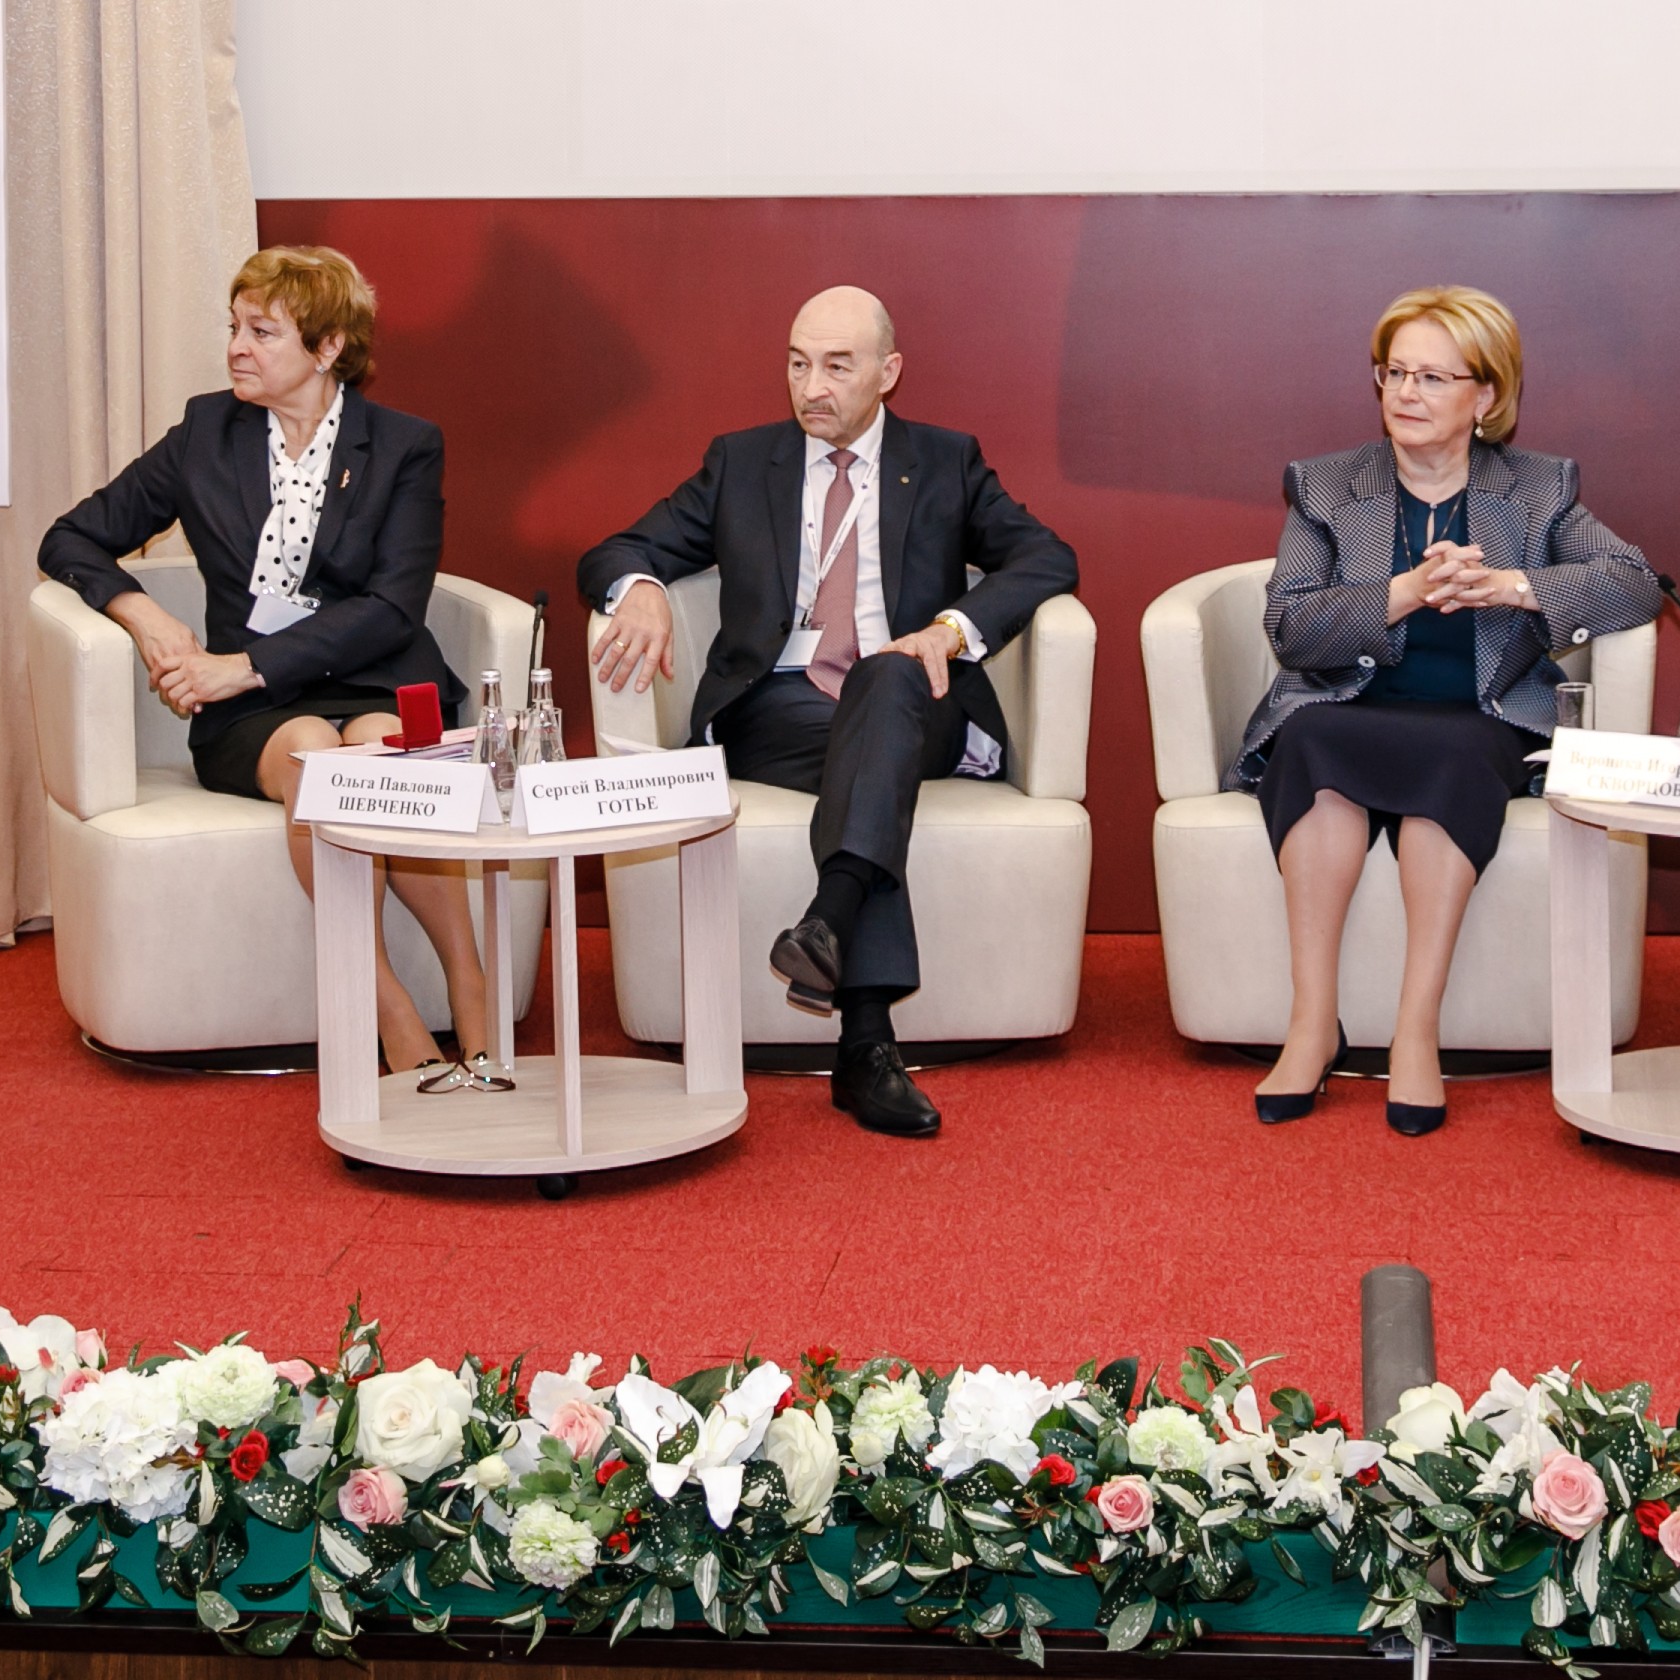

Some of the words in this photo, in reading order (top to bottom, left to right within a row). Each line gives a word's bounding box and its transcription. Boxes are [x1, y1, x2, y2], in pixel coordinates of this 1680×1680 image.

[331, 773, 375, 791] Ольга
[380, 776, 452, 796] Павловна
[532, 778, 590, 801] Сергей
[595, 768, 716, 793] Владимирович
[338, 794, 436, 817] ШЕВЧЕНКО
[598, 795, 658, 815] ГОТЬЕ
